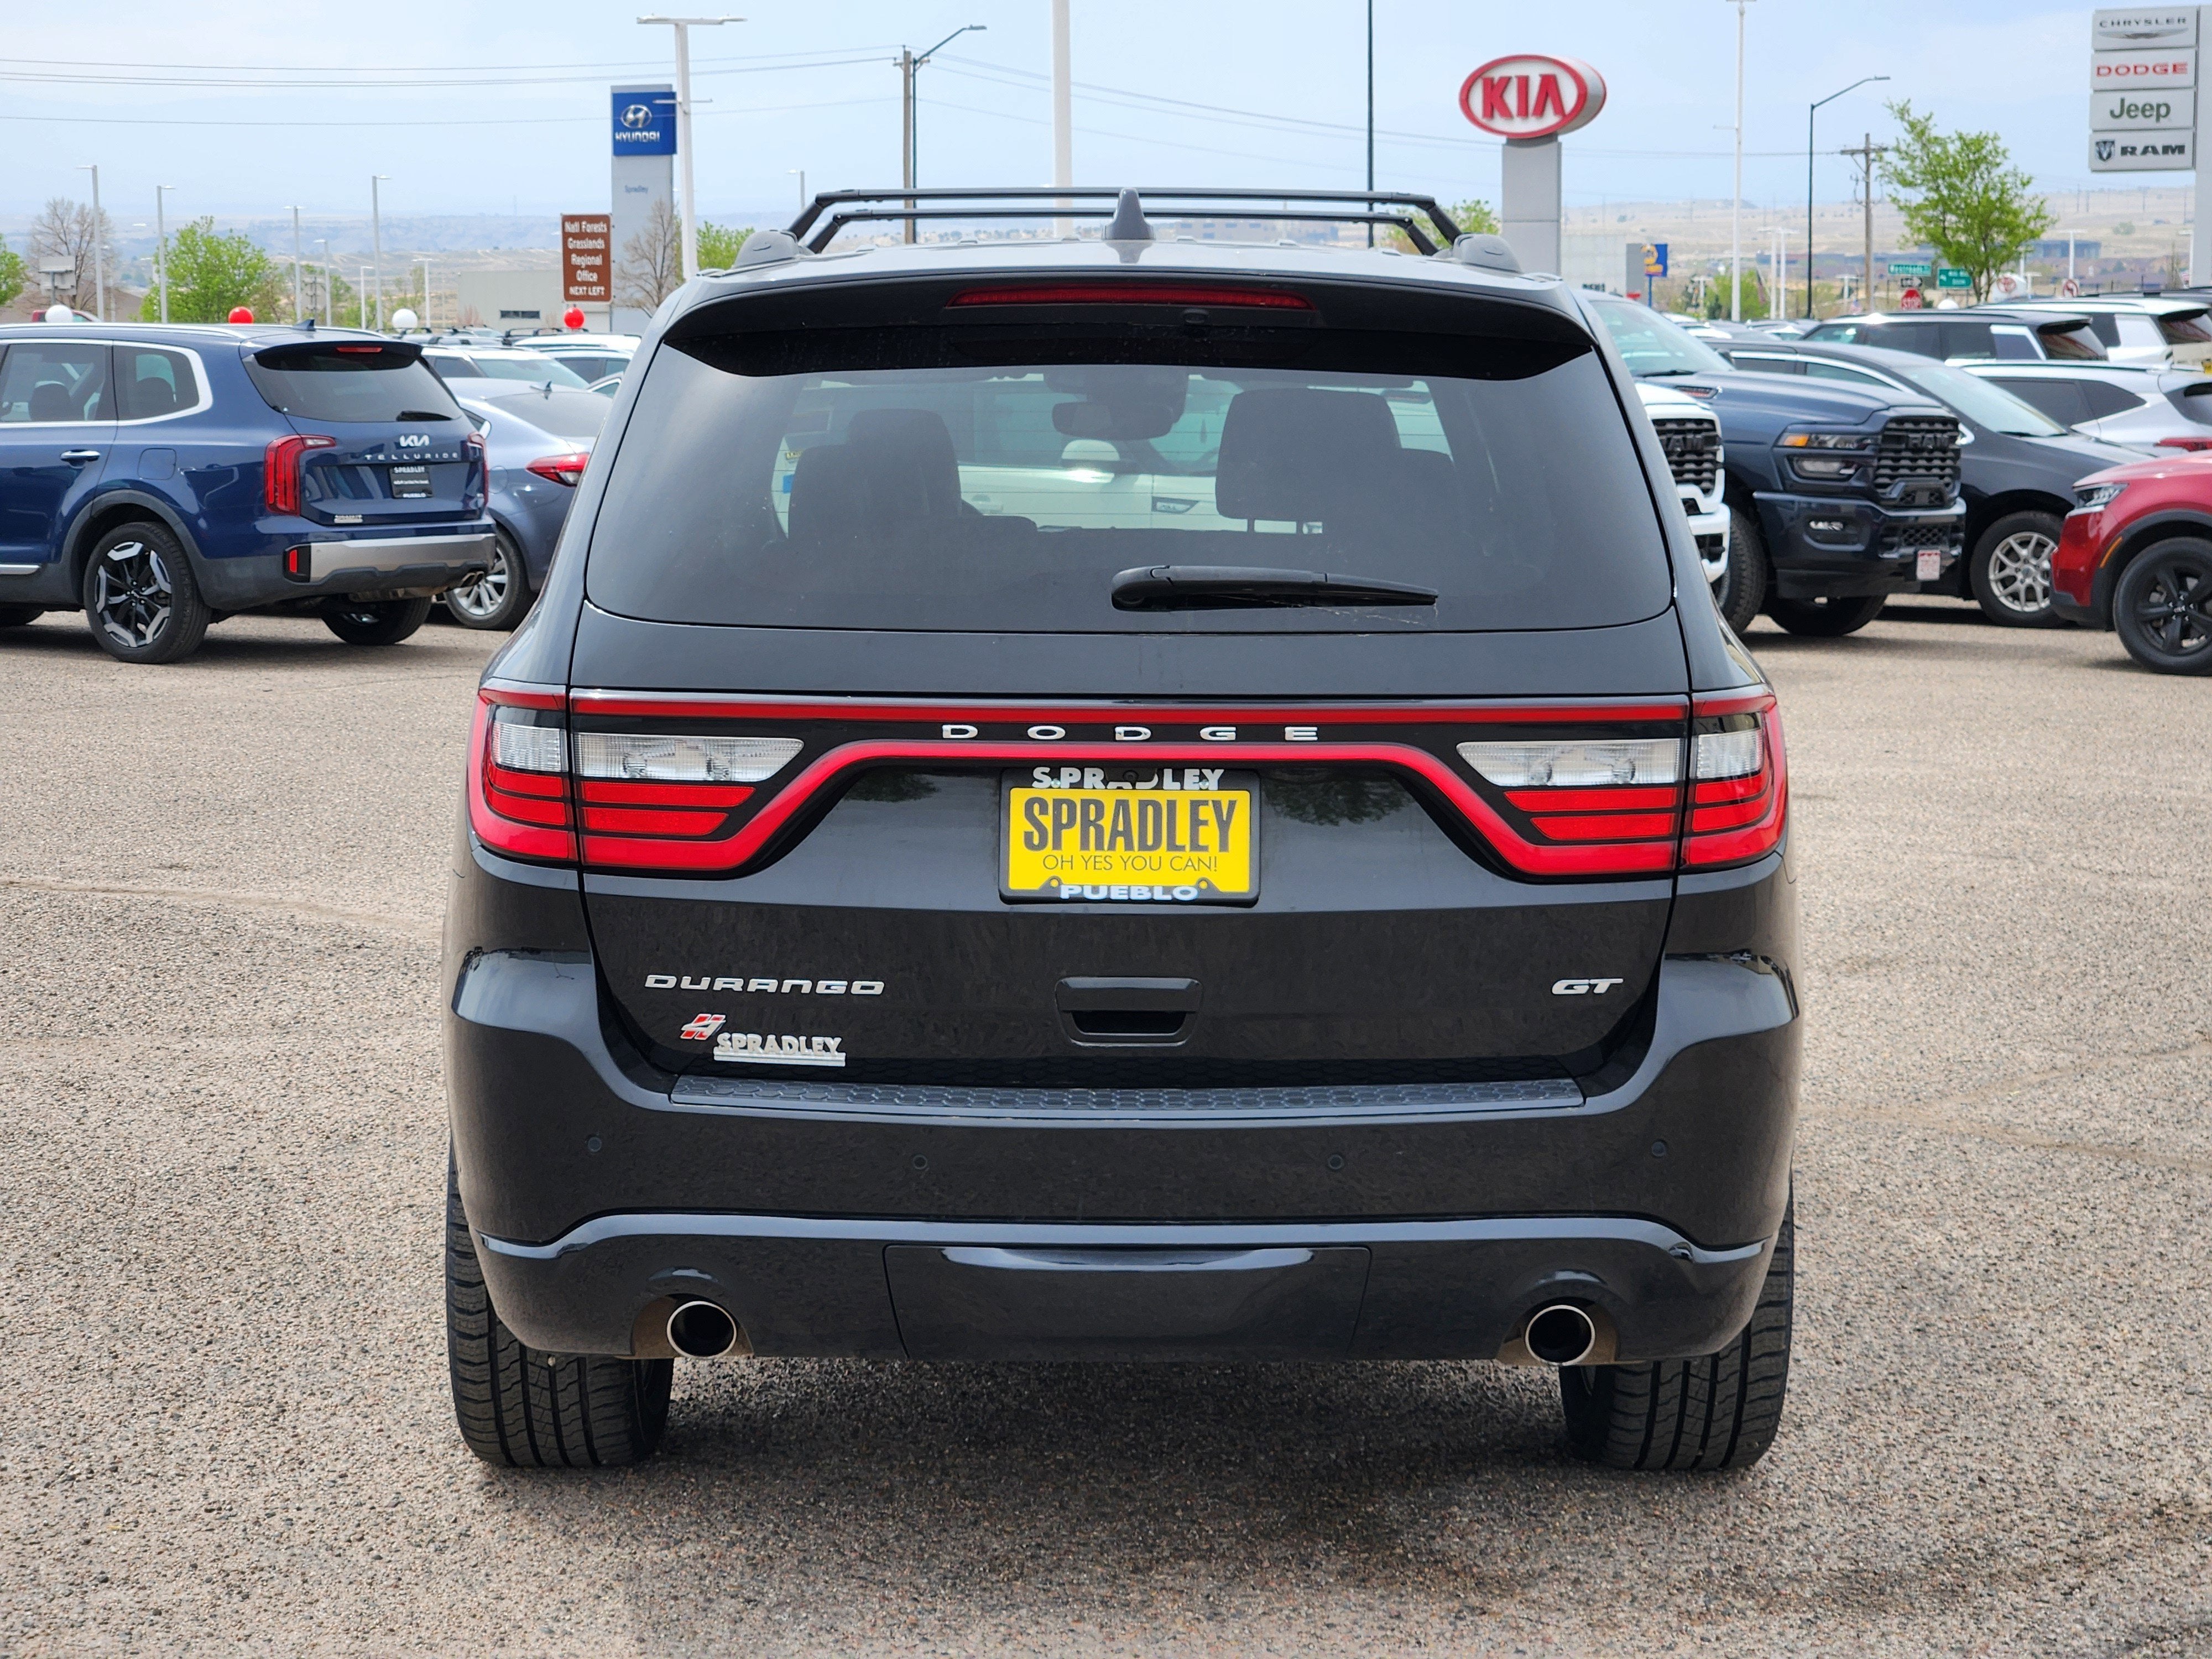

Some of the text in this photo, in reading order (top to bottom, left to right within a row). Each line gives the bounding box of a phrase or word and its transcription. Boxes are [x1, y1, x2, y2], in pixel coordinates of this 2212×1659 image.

[2099, 17, 2187, 28] CHRYSLER
[2096, 61, 2188, 77] DODGE
[1483, 74, 1566, 119] KIA
[2110, 97, 2171, 123] Jeep
[615, 131, 660, 142] HYUNDAI
[2120, 144, 2186, 156] RAM
[571, 253, 603, 268] Regional
[576, 269, 598, 282] Office
[569, 286, 605, 295] NEXT LEFT
[364, 452, 458, 461] TELLURIDE
[942, 724, 1318, 741] DODGE
[1024, 797, 1238, 853] SPRADLEY
[1043, 854, 1218, 872] OH YES YOU CAN!
[1060, 884, 1199, 901] PUEBLO
[644, 974, 885, 995] DURANGO
[1552, 978, 1624, 995] GT
[716, 1032, 842, 1056] SPRADLEY
